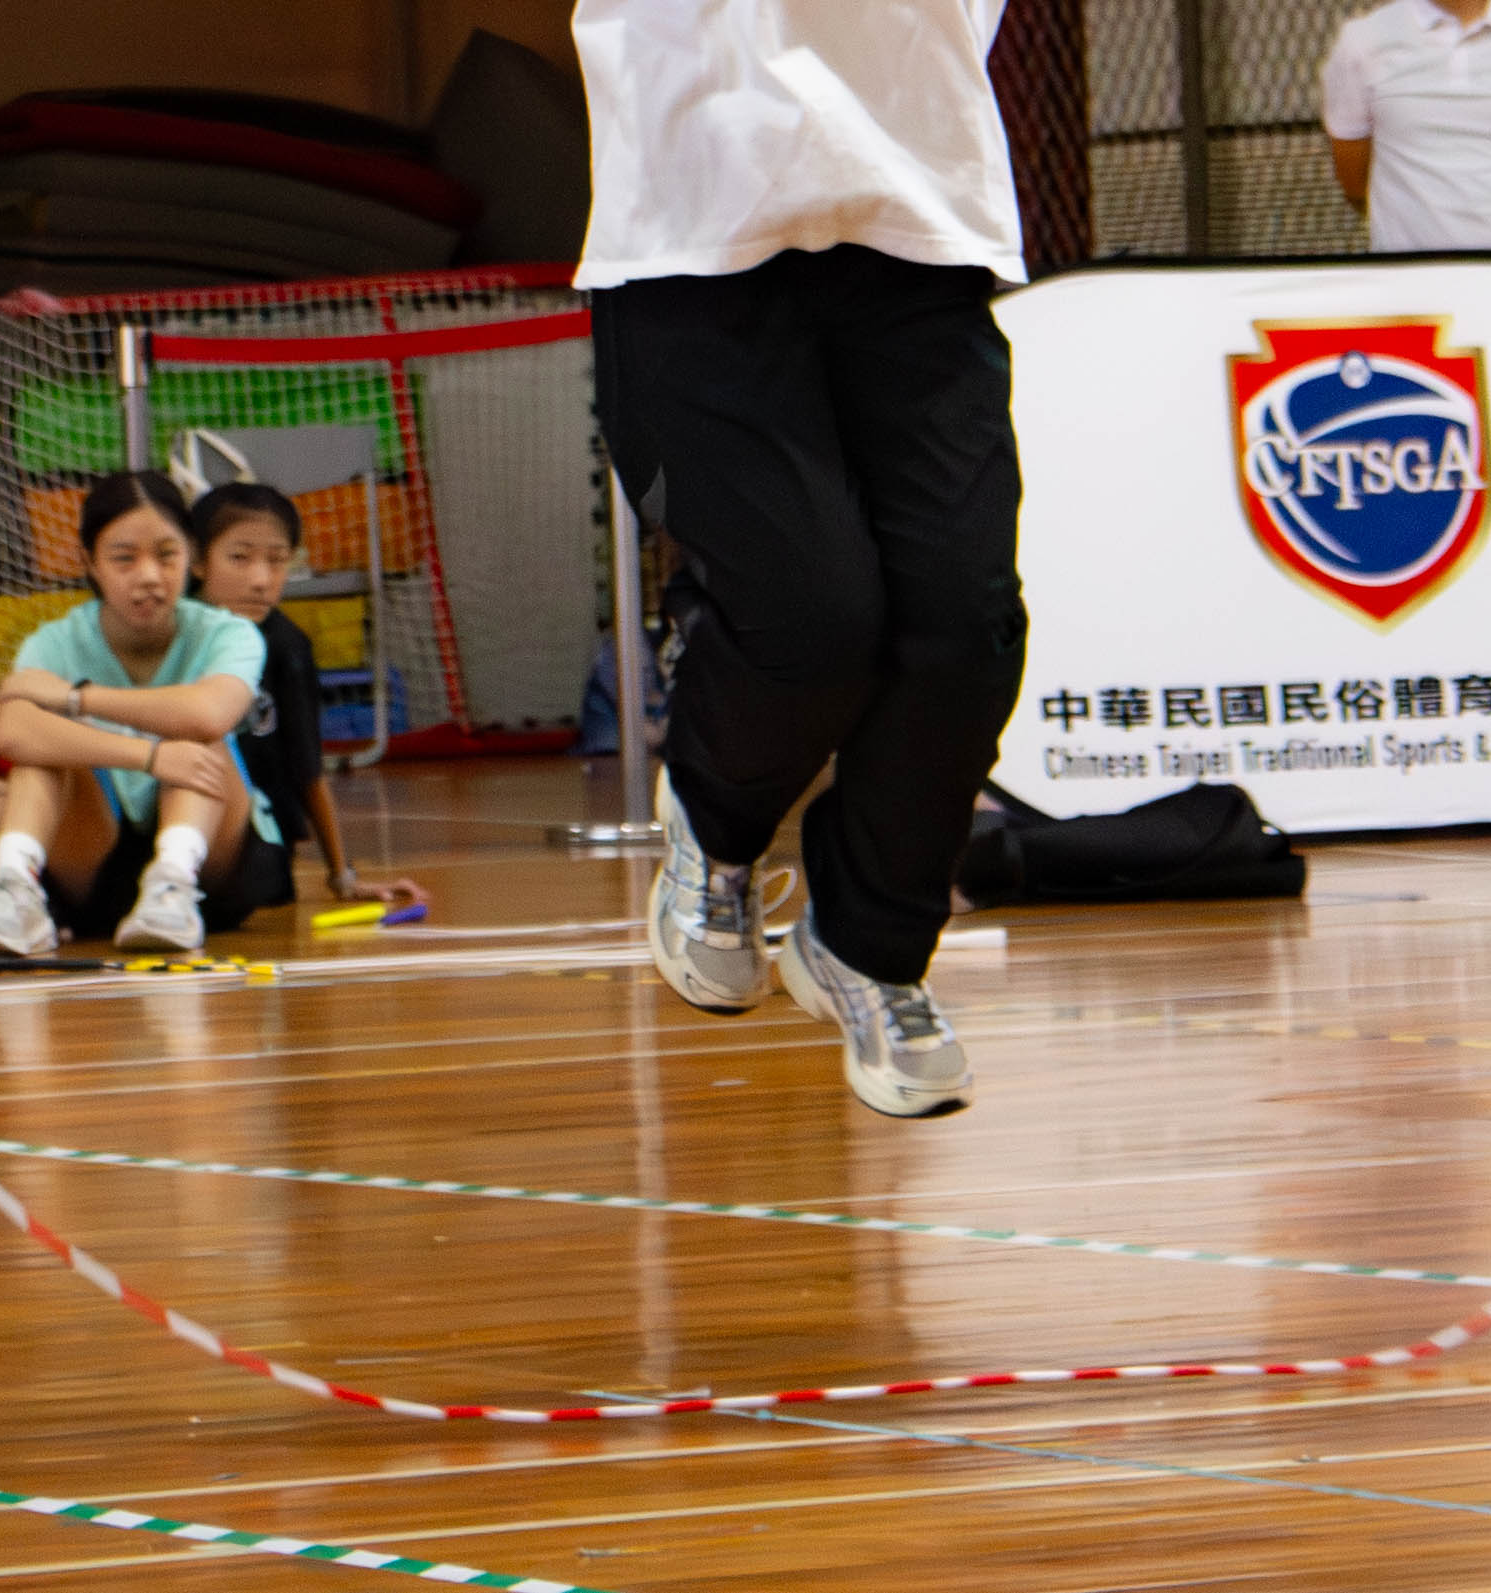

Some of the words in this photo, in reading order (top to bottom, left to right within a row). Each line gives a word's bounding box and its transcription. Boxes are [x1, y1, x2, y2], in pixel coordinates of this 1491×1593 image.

[1044, 742, 1149, 779] Chinese
[1156, 743, 1233, 779] Taipei
[1240, 736, 1375, 773] Traditional
[1382, 731, 1463, 775] Sports
